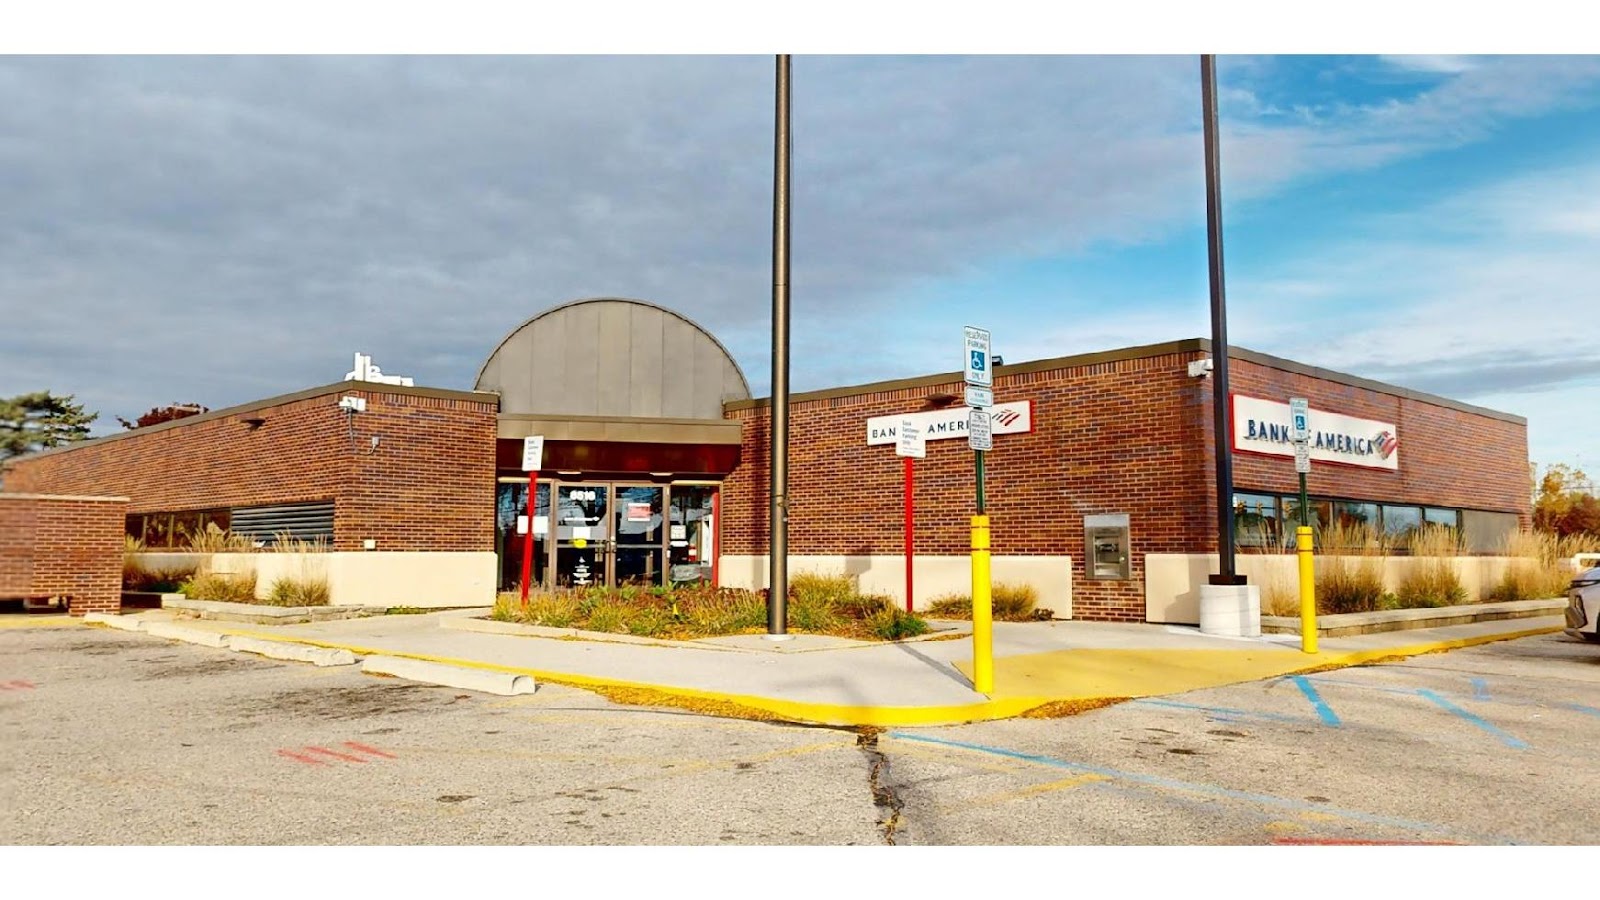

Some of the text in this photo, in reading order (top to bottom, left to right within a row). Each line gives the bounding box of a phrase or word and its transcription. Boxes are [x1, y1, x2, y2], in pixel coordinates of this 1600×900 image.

[872, 419, 969, 439] BAN AMERI
[1247, 419, 1290, 443] BANK
[1315, 431, 1374, 456] AMERICA
